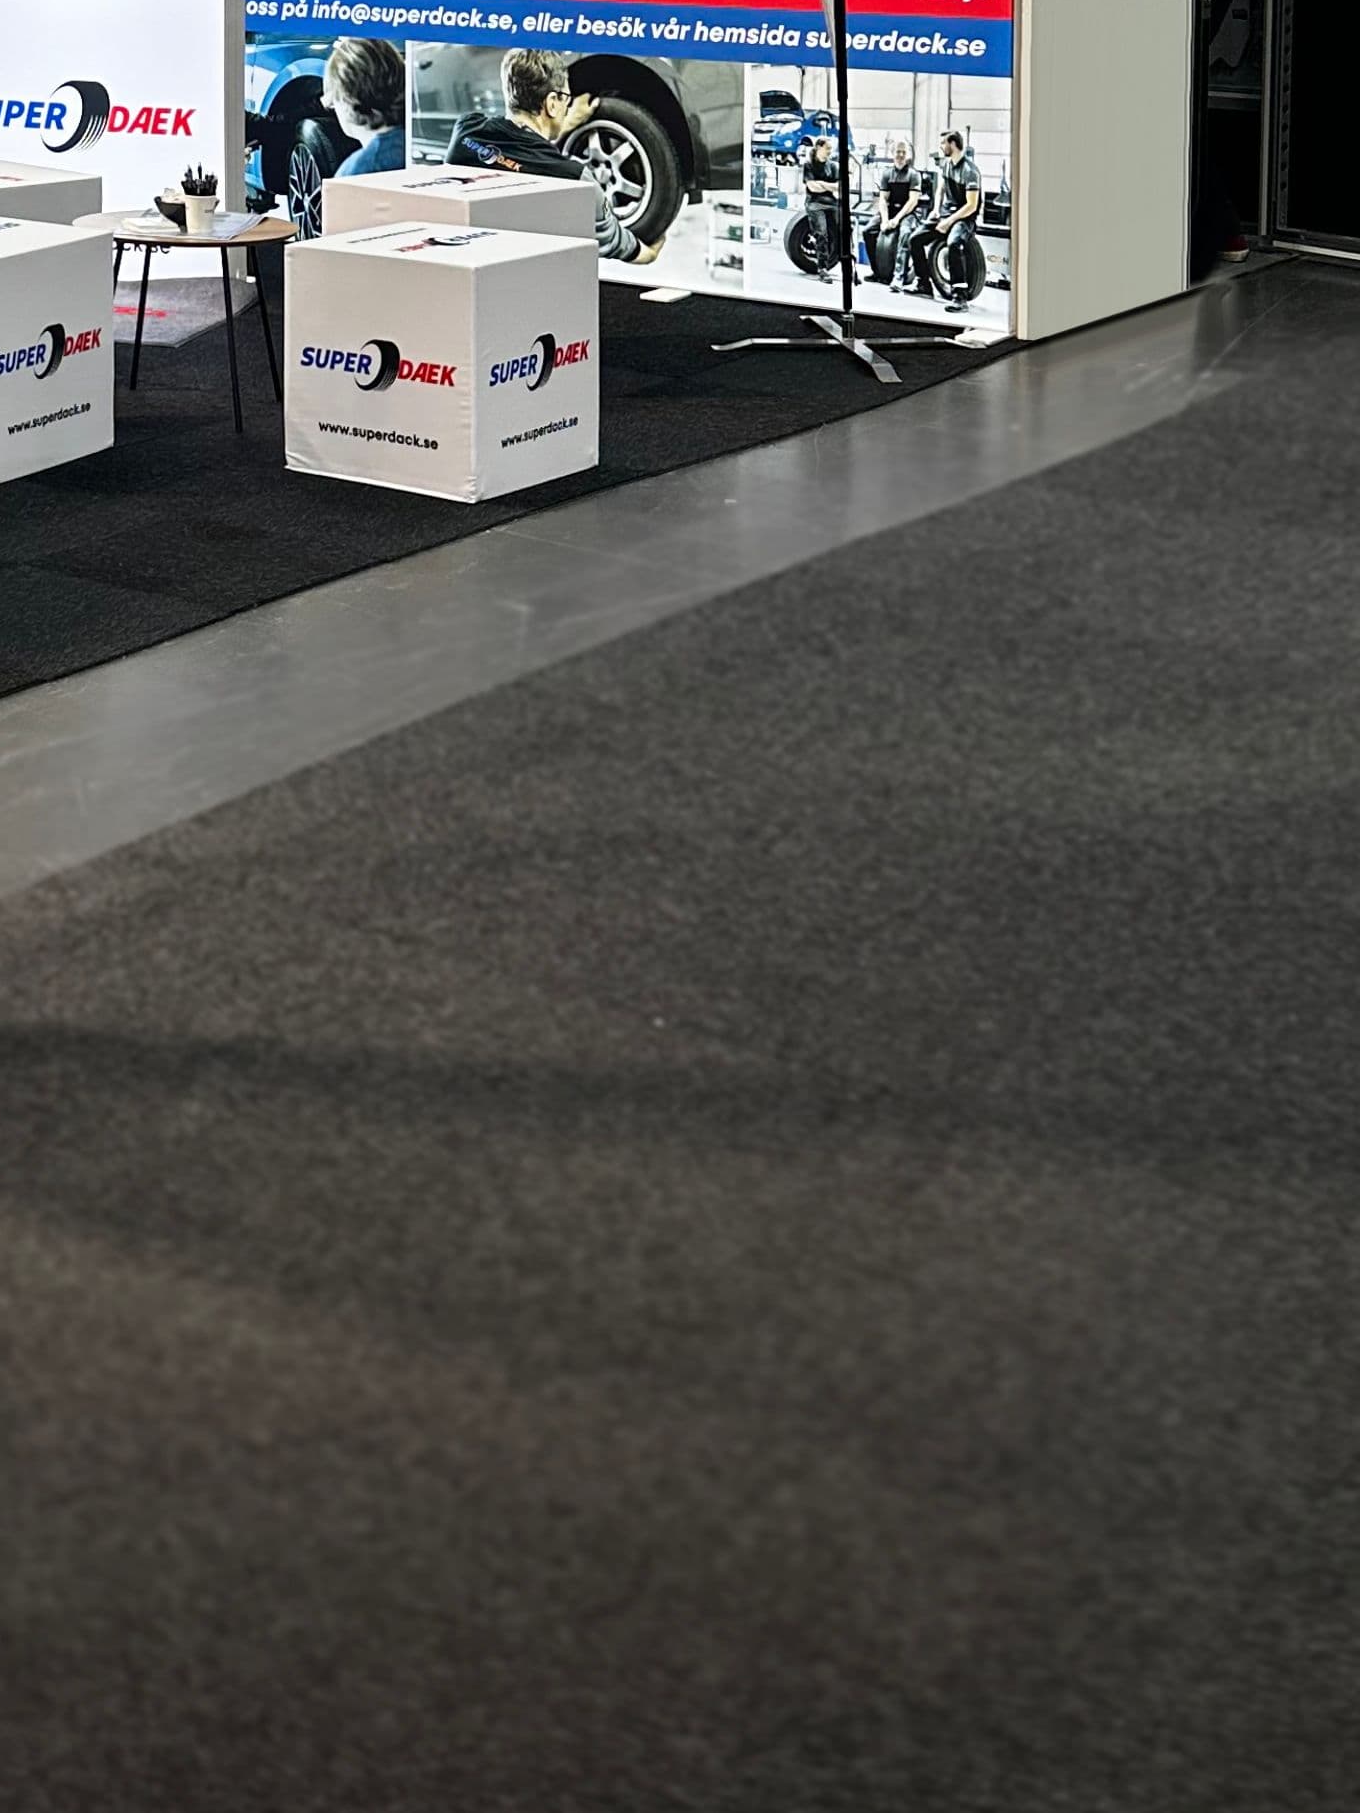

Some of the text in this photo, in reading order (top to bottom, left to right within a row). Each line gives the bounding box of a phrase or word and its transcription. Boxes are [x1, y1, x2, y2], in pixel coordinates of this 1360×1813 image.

[246, 0, 278, 17] oss
[312, 0, 518, 32] info@superdack.se,
[523, 11, 572, 35] eller
[576, 14, 647, 39] besök
[651, 16, 689, 42] vår
[695, 22, 800, 49] hemsida
[107, 105, 197, 137] DAEK
[63, 328, 101, 357] DAEK
[301, 347, 456, 387] SUPER DAEK
[489, 339, 590, 387] SUPER DAEK
[8, 402, 91, 436] www.superdack.se
[319, 420, 438, 451] www.superdack.se
[501, 416, 579, 448] www.superdack.se
